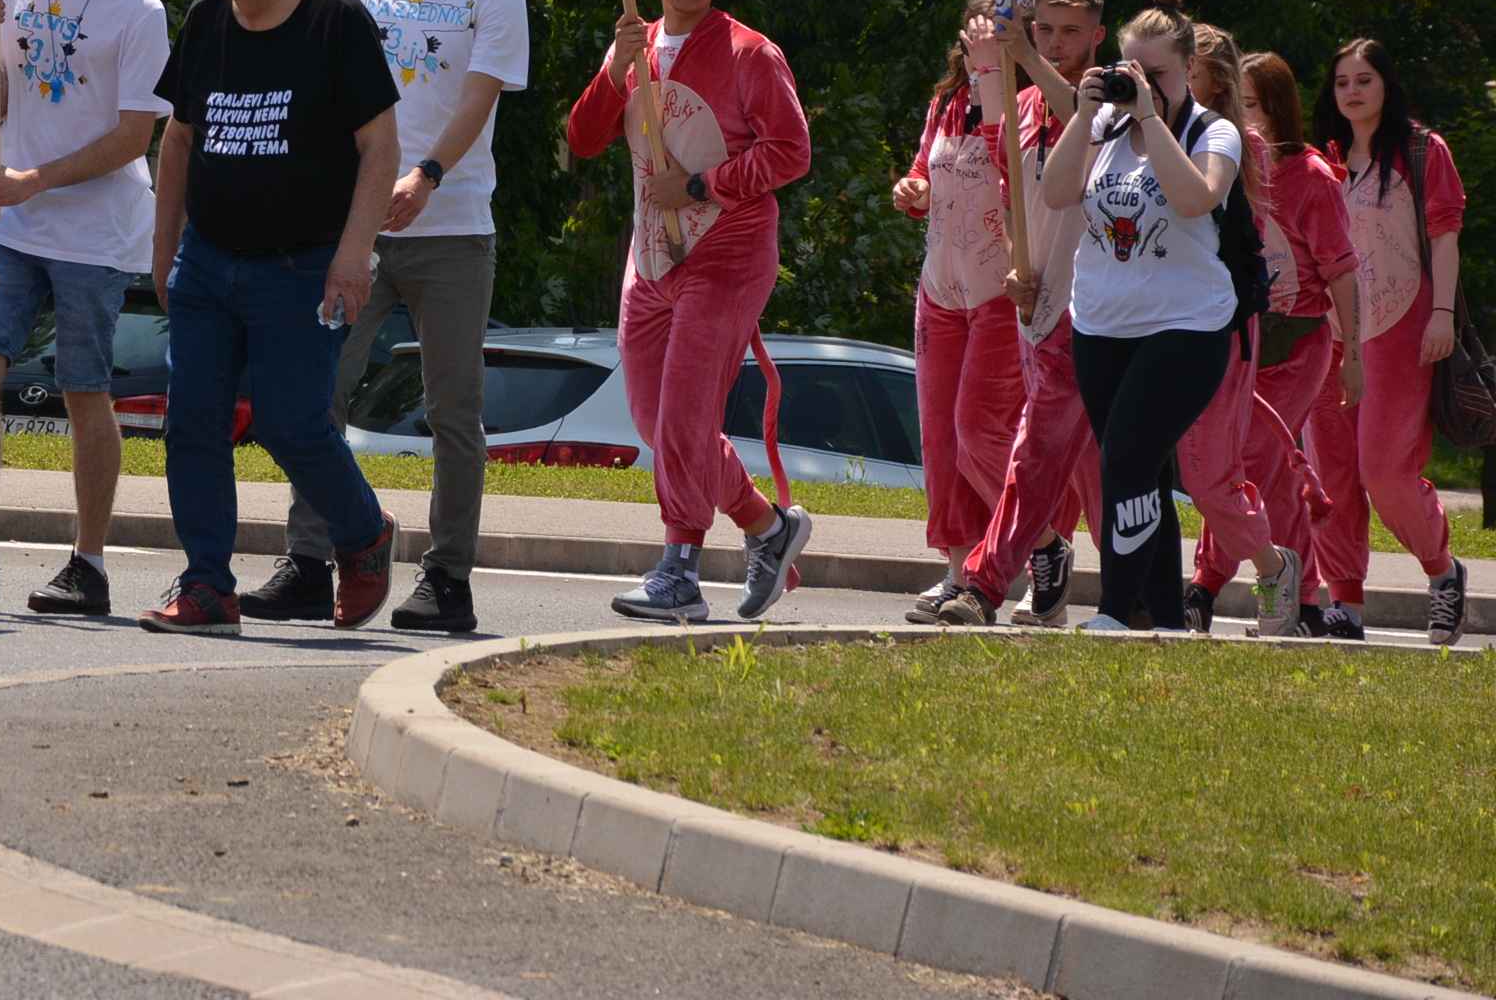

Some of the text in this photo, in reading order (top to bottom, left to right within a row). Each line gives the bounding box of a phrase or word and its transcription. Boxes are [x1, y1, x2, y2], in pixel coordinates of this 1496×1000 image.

[206, 89, 293, 108] KRALJEVI SMO
[205, 106, 288, 124] KAKVIH NEMA
[208, 124, 280, 141] U ZBORNICI
[204, 139, 289, 155] GLAVNA TEMA
[1106, 191, 1140, 208] CLUB
